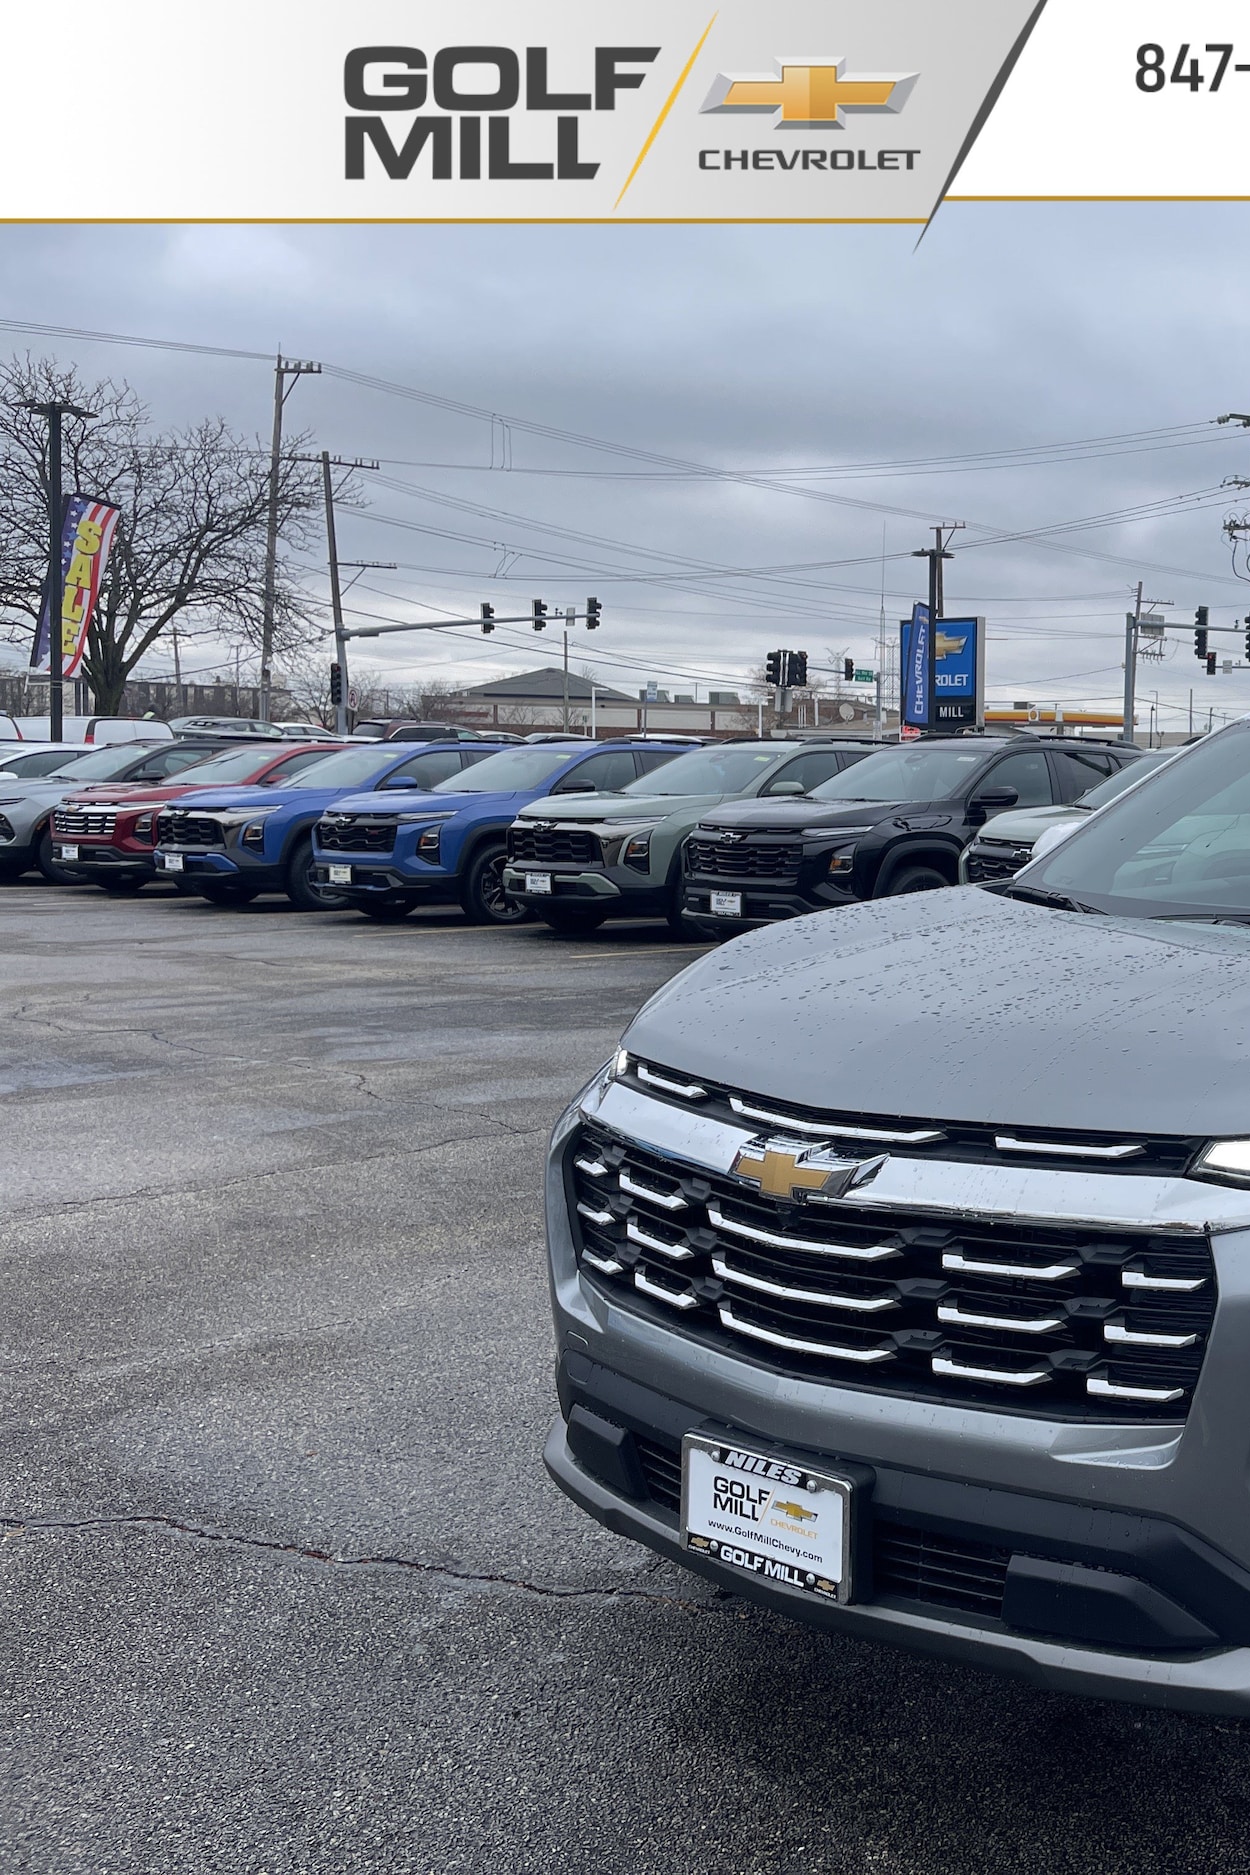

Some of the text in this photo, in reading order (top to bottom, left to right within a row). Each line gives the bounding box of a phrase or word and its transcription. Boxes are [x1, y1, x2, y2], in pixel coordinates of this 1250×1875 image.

[62, 519, 103, 657] SALE
[935, 674, 969, 687] ROLET
[939, 706, 964, 718] MILL
[724, 1451, 802, 1486] NILES
[713, 1476, 770, 1505] GOLF
[713, 1493, 760, 1522] MILL
[707, 1519, 823, 1563] www.GolfMillChevy.com
[770, 1518, 818, 1540] CHEVROLET
[720, 1545, 805, 1588] GOLF MILL
